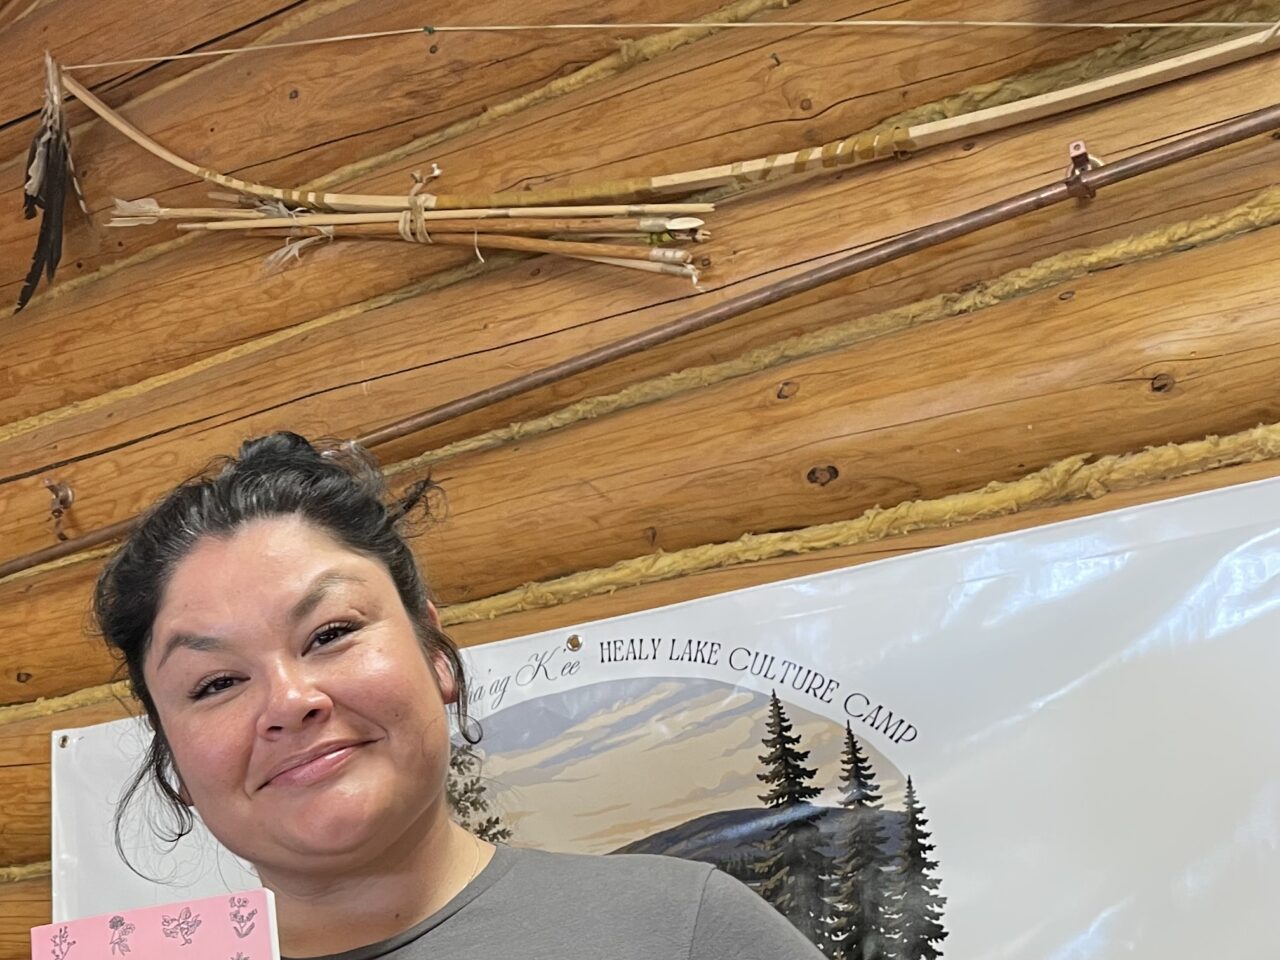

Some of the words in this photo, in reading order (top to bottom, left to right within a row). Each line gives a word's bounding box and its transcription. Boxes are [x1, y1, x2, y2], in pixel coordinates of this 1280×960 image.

[599, 638, 662, 664] HEALY
[669, 638, 722, 666] LAKE
[728, 646, 840, 704] CULTURE
[843, 692, 918, 745] CAMP
